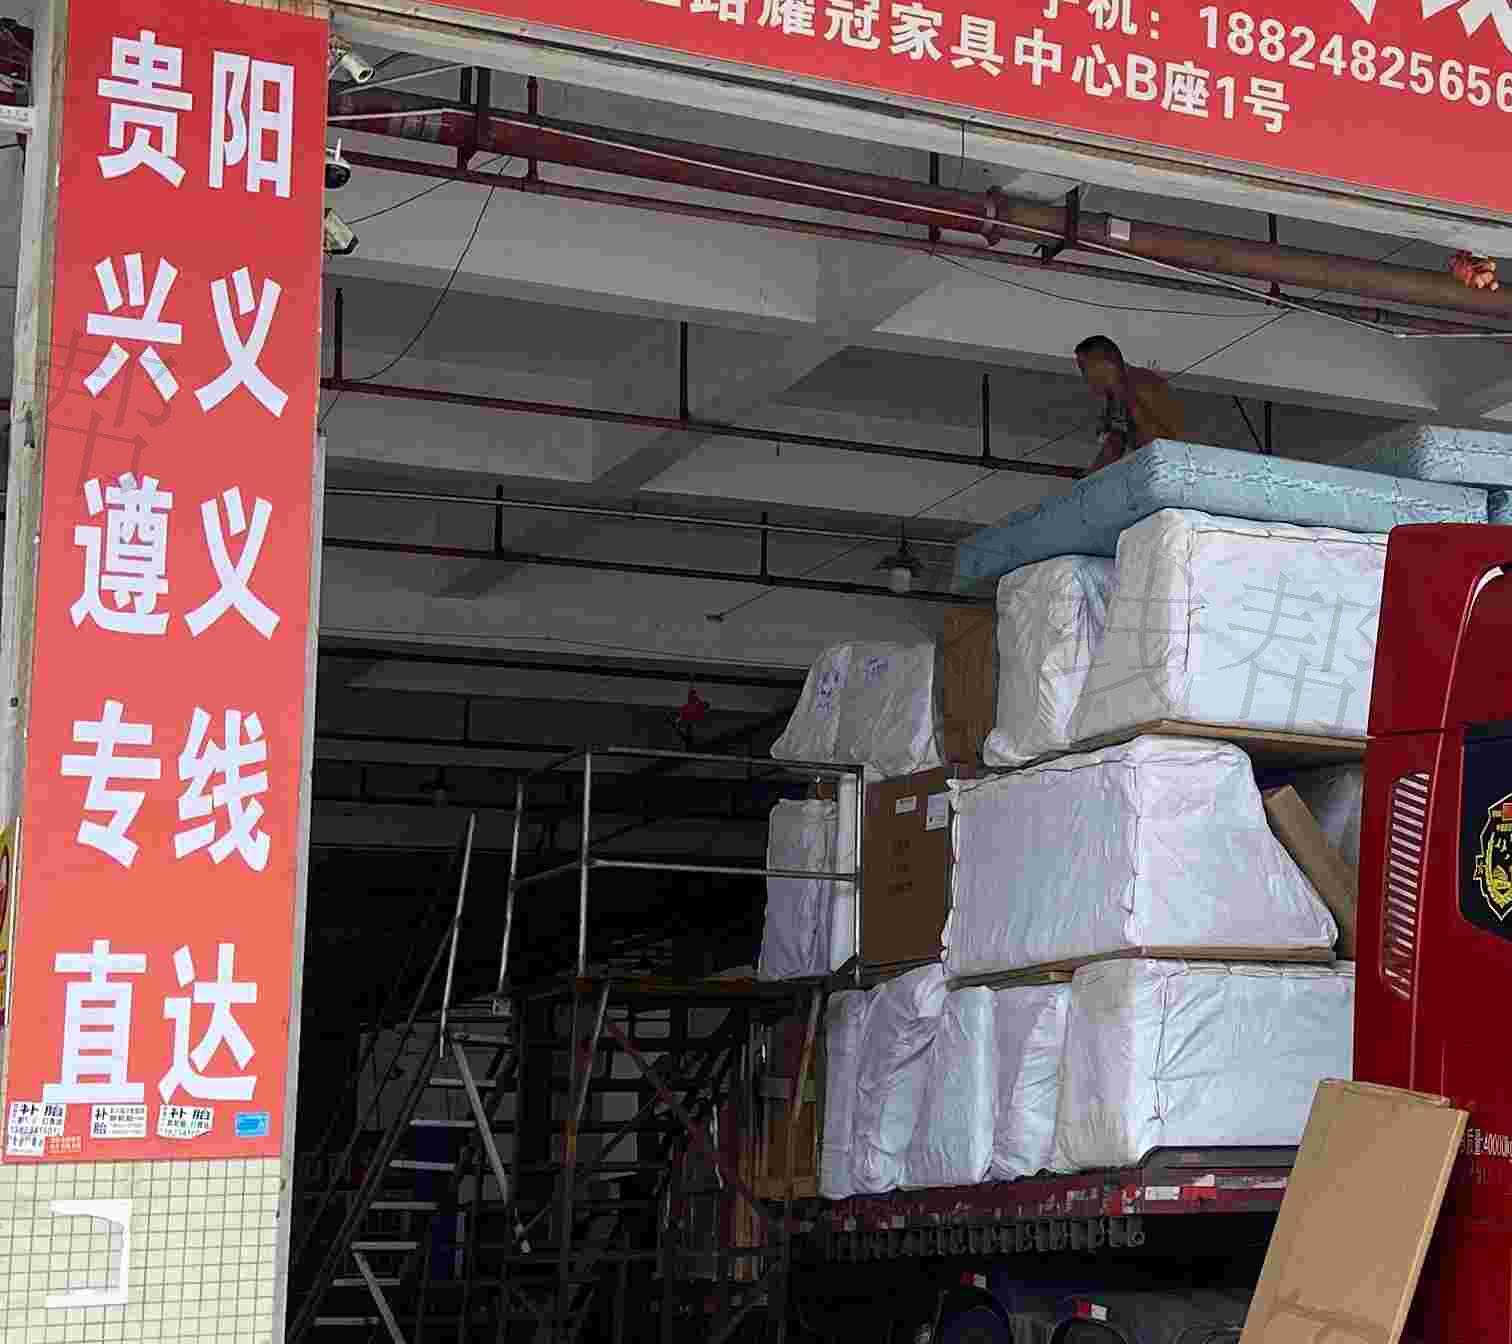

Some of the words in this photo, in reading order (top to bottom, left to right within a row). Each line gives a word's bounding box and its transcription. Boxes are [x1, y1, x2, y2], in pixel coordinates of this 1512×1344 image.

[97, 31, 295, 199] 贵阳
[83, 252, 289, 418] 兴义
[70, 471, 281, 641] 遵义
[61, 700, 271, 872] 专线
[42, 939, 258, 1105] 直达
